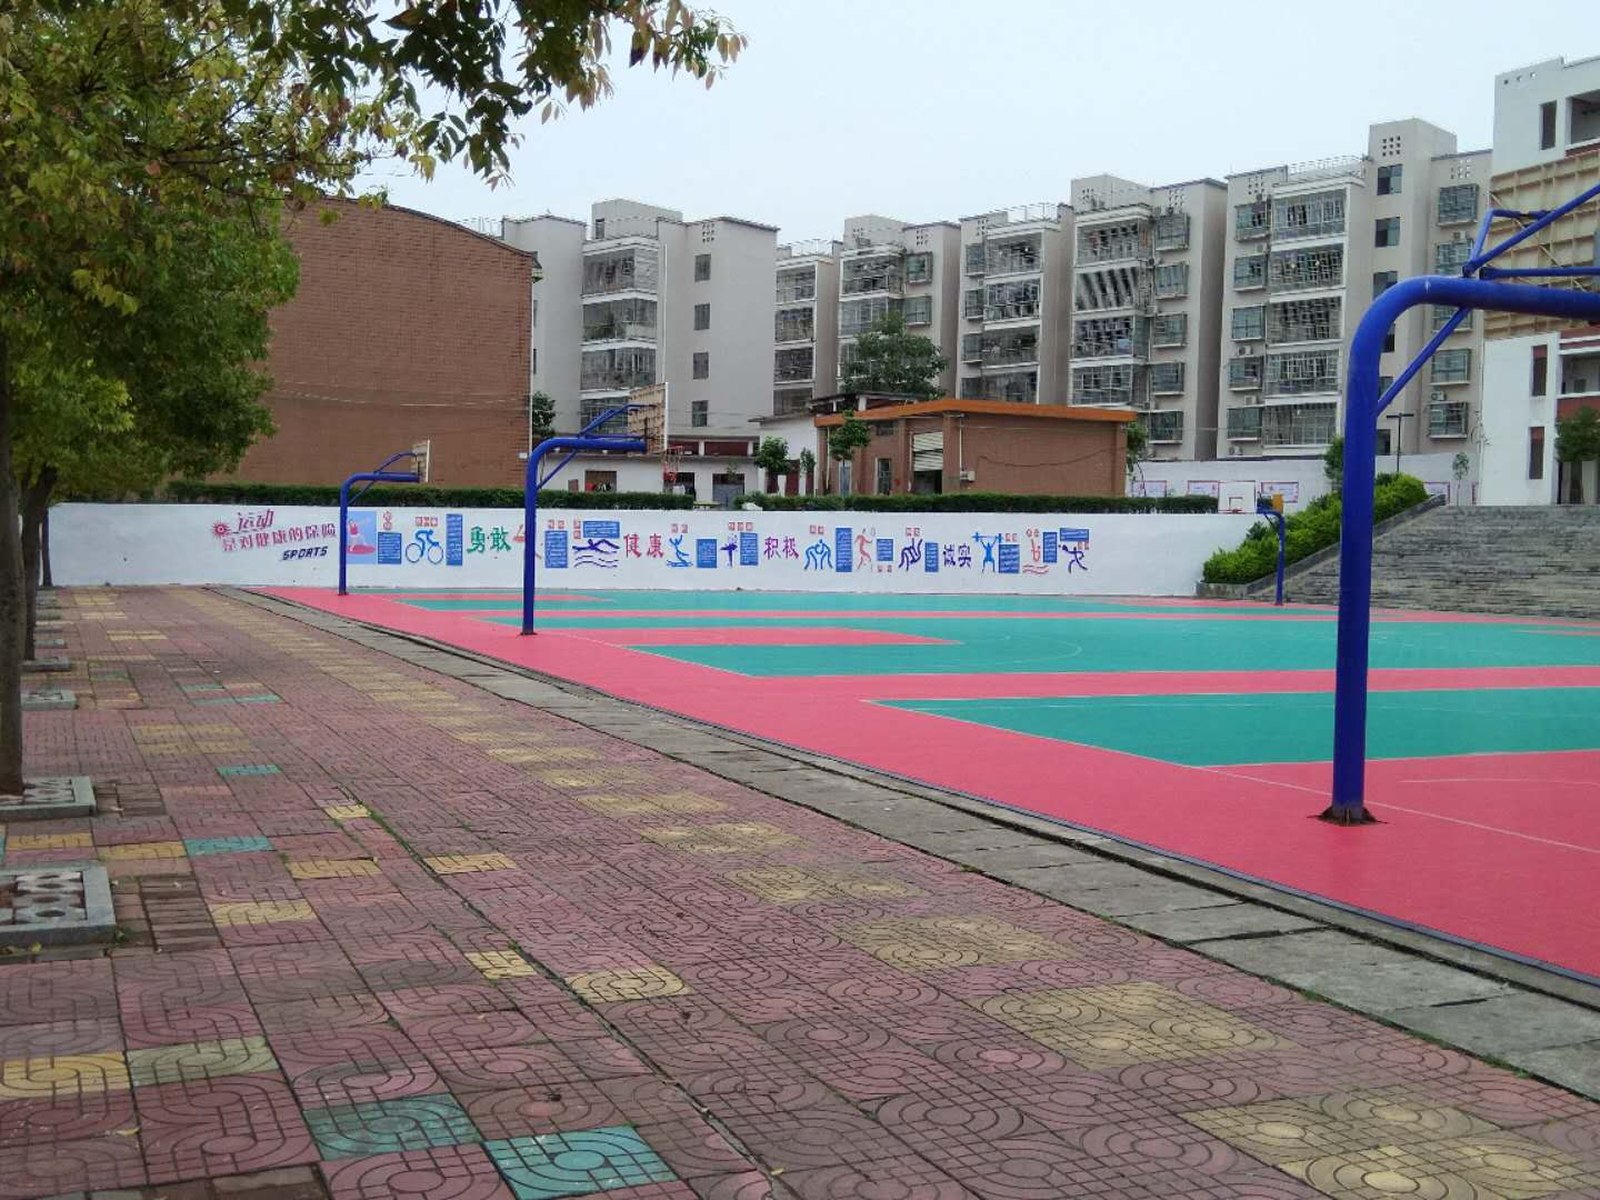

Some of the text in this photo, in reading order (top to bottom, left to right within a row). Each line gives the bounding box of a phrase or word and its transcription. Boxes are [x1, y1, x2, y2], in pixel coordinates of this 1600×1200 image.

[466, 525, 512, 553] 勇敢
[623, 533, 665, 558] 健康
[763, 535, 799, 560] 积极
[281, 546, 328, 561] SPORTS
[943, 542, 972, 567] 诚实
